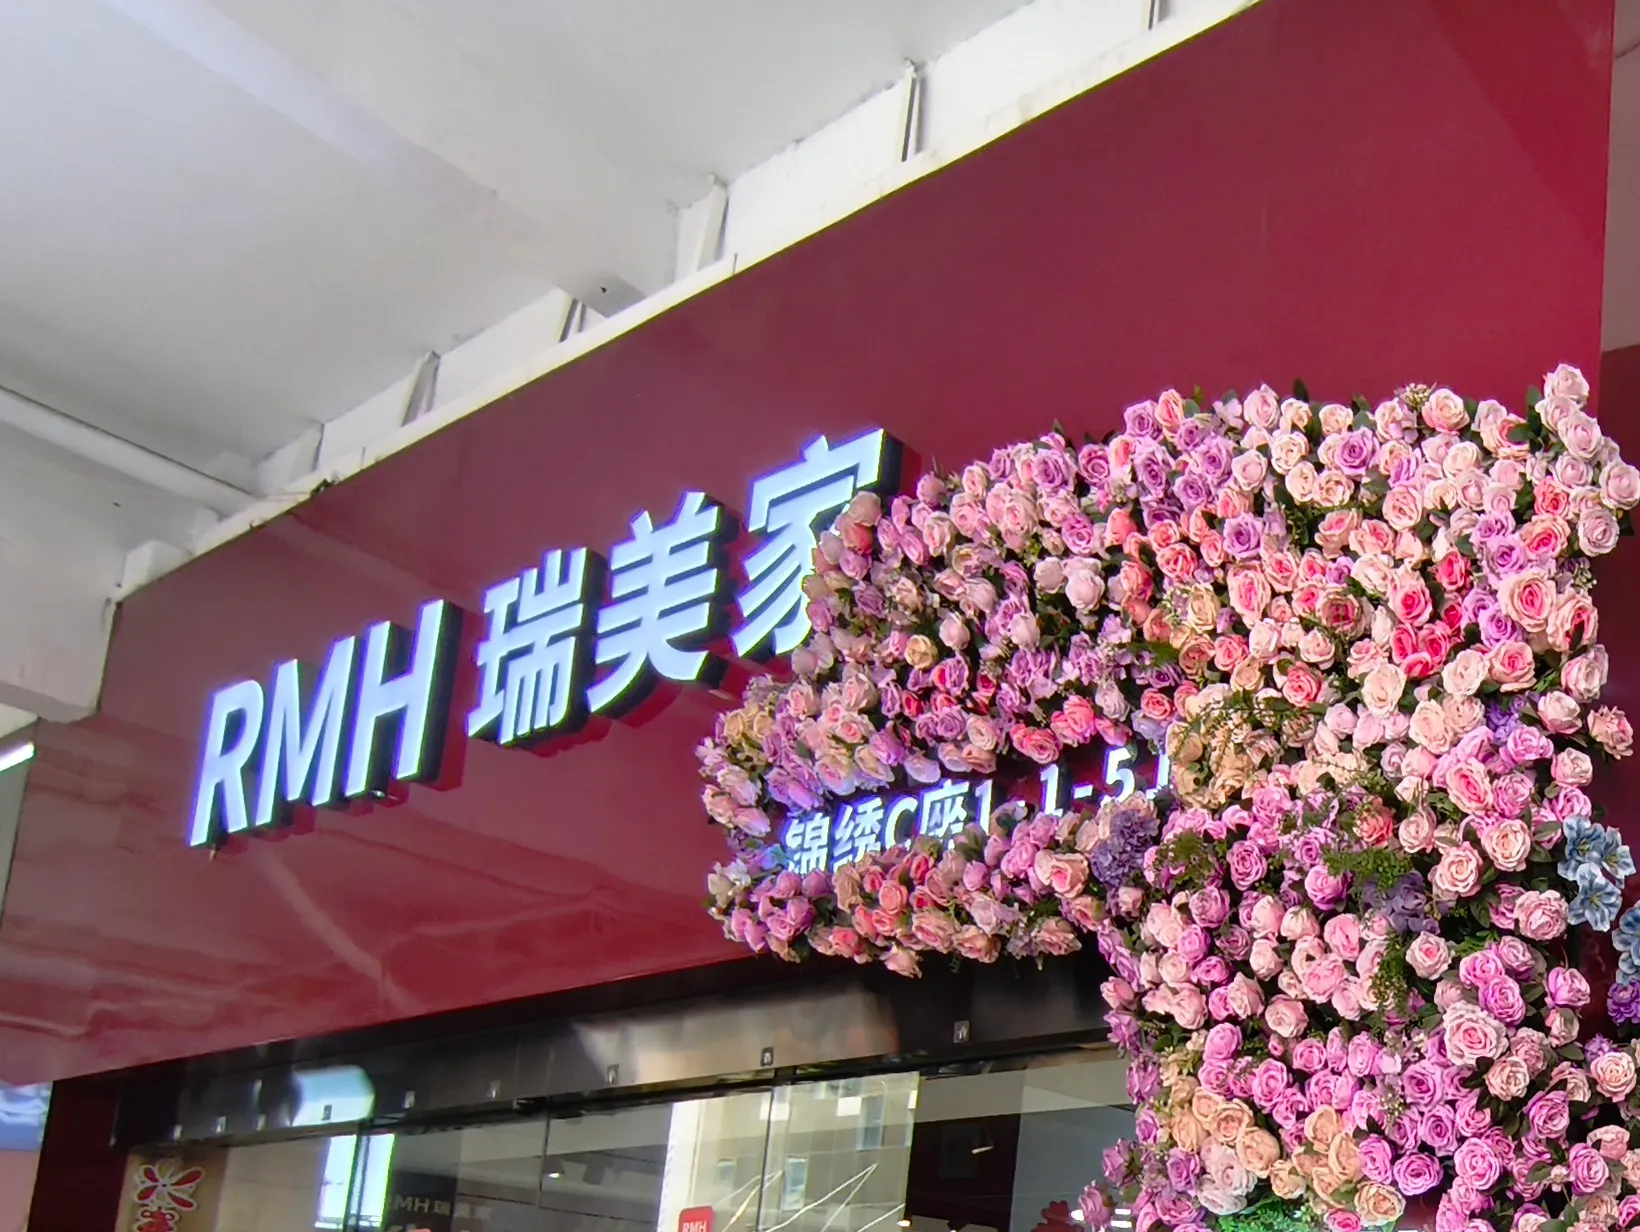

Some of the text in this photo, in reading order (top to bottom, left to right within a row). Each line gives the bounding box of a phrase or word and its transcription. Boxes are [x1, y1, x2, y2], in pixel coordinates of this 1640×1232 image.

[189, 427, 886, 847] RMH 瑞美家
